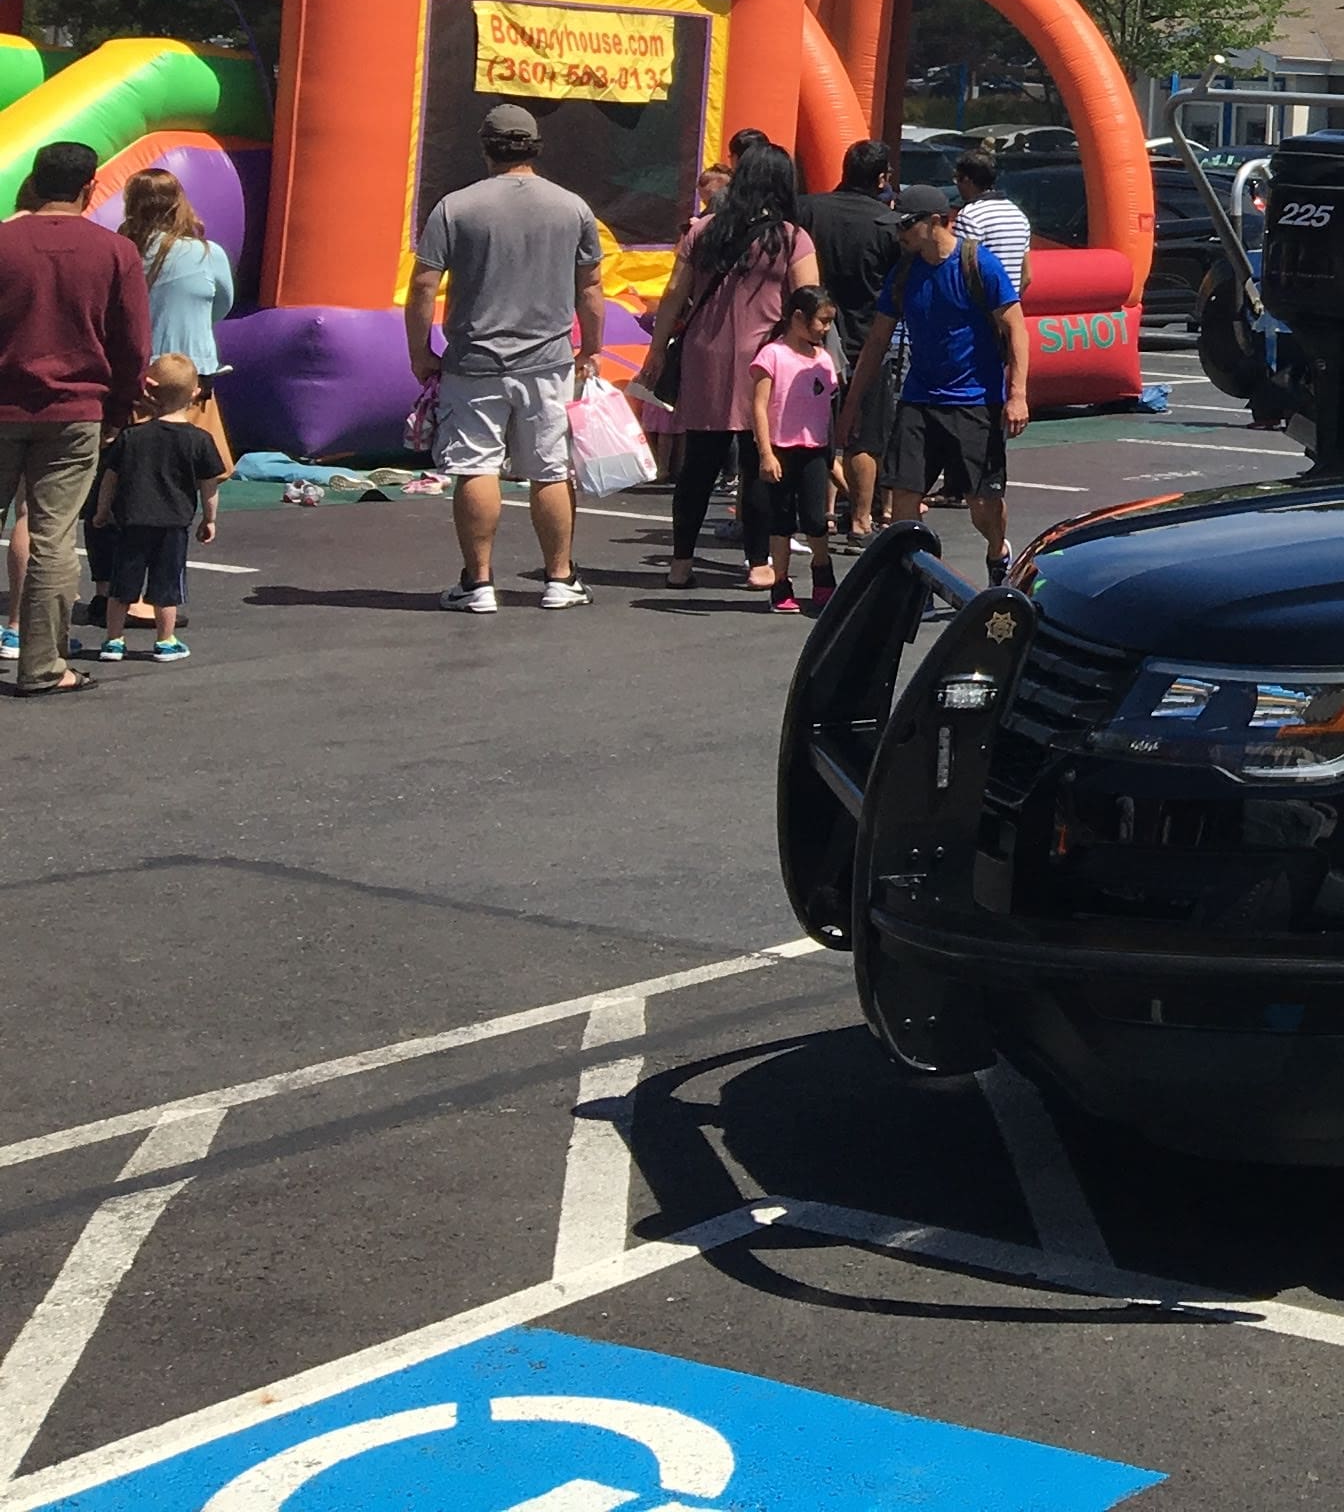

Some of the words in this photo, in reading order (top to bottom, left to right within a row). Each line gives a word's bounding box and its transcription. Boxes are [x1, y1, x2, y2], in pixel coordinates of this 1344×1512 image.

[487, 57, 555, 89] (360)
[567, 64, 668, 90] 53-013
[1279, 203, 1334, 227] 225
[1038, 311, 1128, 353] SHOT
